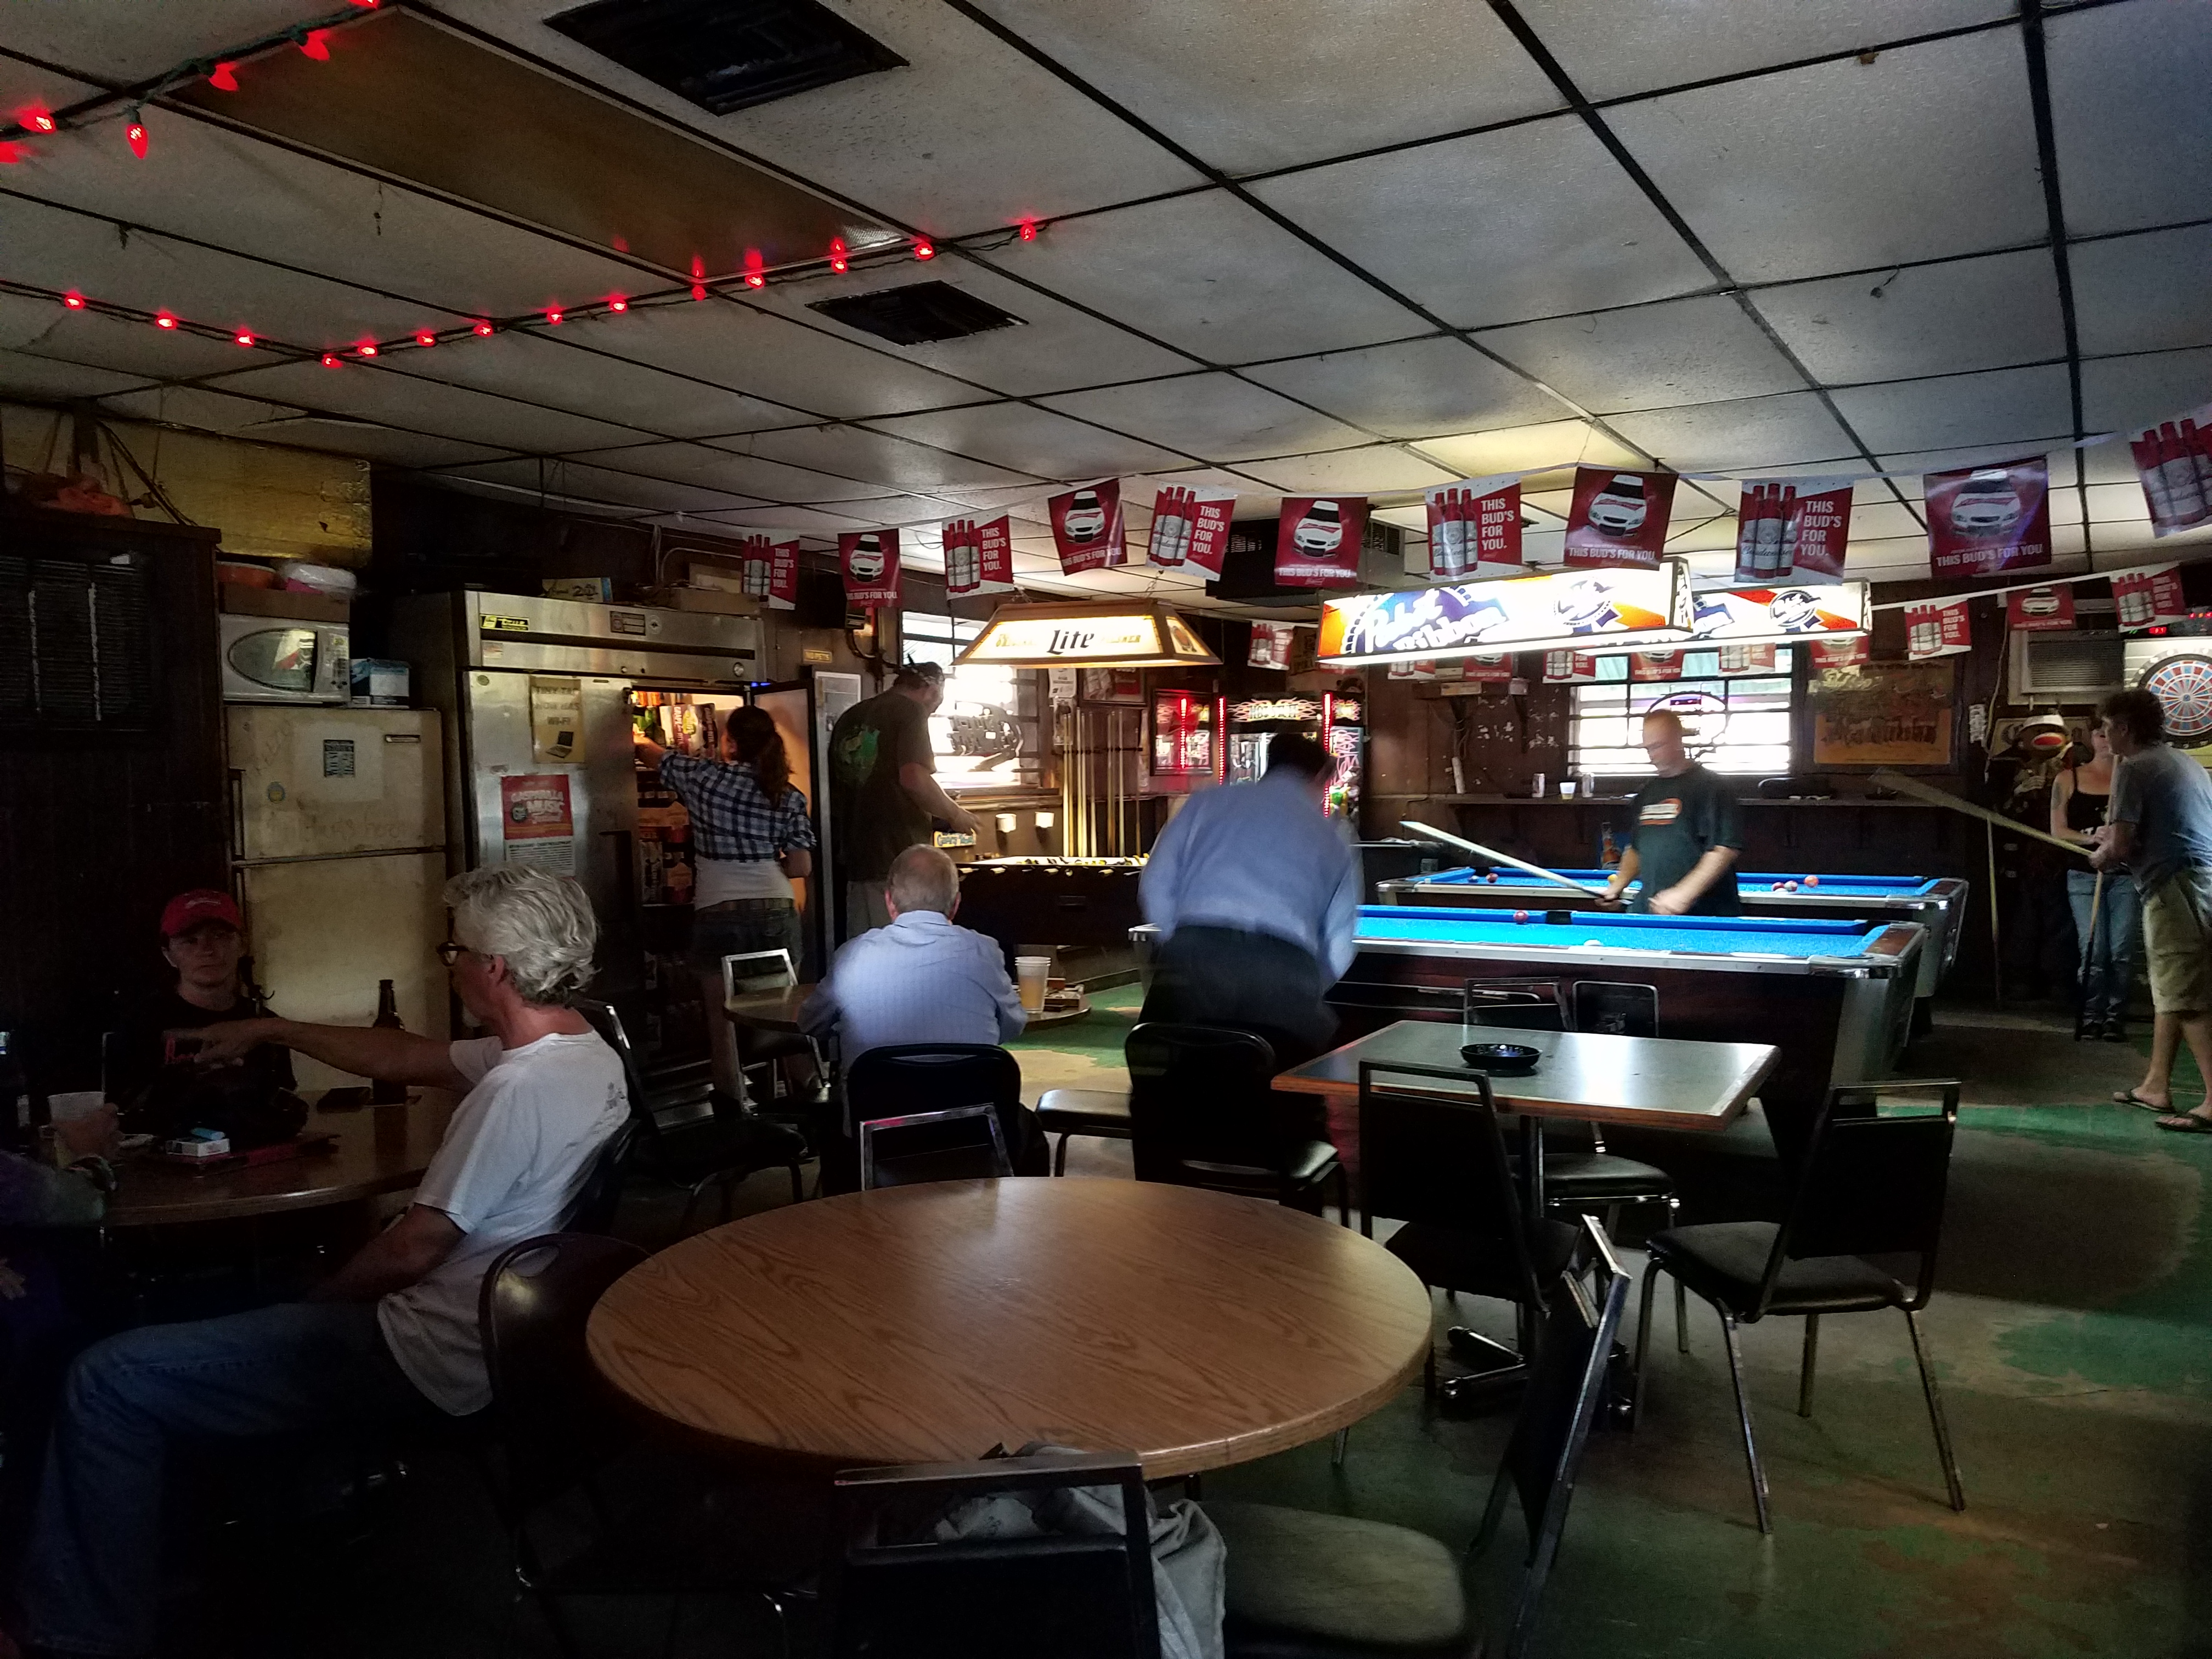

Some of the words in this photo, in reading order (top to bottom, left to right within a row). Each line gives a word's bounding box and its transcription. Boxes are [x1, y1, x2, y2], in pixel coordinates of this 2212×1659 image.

[1481, 498, 1506, 511] THIS
[1805, 500, 1834, 513] THIS
[1200, 505, 1220, 518] THIS
[1482, 510, 1515, 524] BUD'S
[1197, 518, 1225, 532] BUD'S
[1803, 515, 1842, 528] BUD'S
[981, 527, 1000, 538] THIS
[1194, 529, 1213, 541] FOR
[1482, 525, 1503, 537] FOR
[1802, 529, 1827, 541] FOR
[982, 537, 1006, 550] BUD'S
[1193, 541, 1212, 554] YOU.
[1482, 538, 1508, 550] YOU.
[983, 550, 998, 561] FOR
[1092, 550, 1105, 558] FOR
[1568, 548, 1589, 557] THIS
[1590, 548, 1616, 558] BUD'S
[1617, 549, 1635, 559] FOR
[1801, 544, 1829, 556] YOU.
[1936, 556, 1960, 566] THIS
[1962, 549, 1996, 563] BUD'S
[1997, 546, 2019, 559] FOR
[983, 560, 1002, 571] YOU.
[774, 569, 787, 578] FOR
[1046, 630, 1094, 654] Lite
